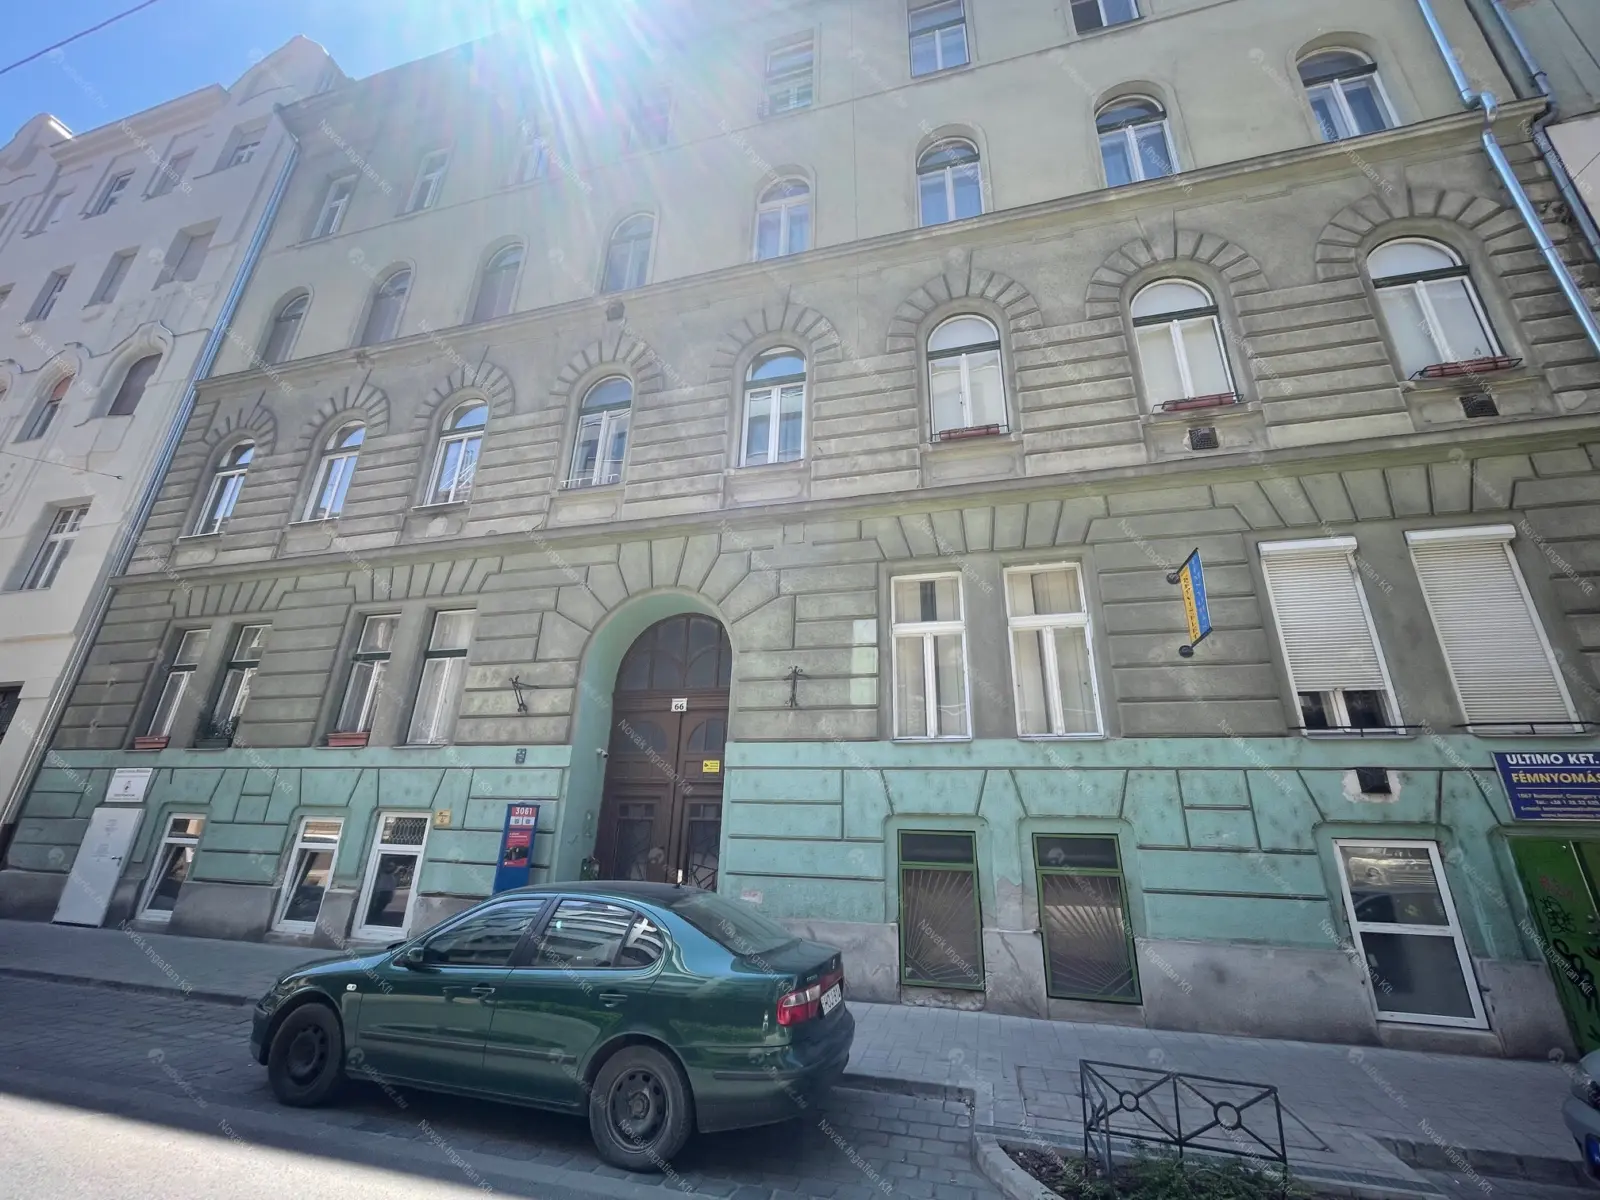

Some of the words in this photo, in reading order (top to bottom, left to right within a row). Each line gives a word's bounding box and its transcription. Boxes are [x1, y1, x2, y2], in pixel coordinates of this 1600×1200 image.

[674, 702, 684, 710] 66
[1505, 753, 1563, 765] ULTIMO
[1567, 753, 1599, 764] KFT.
